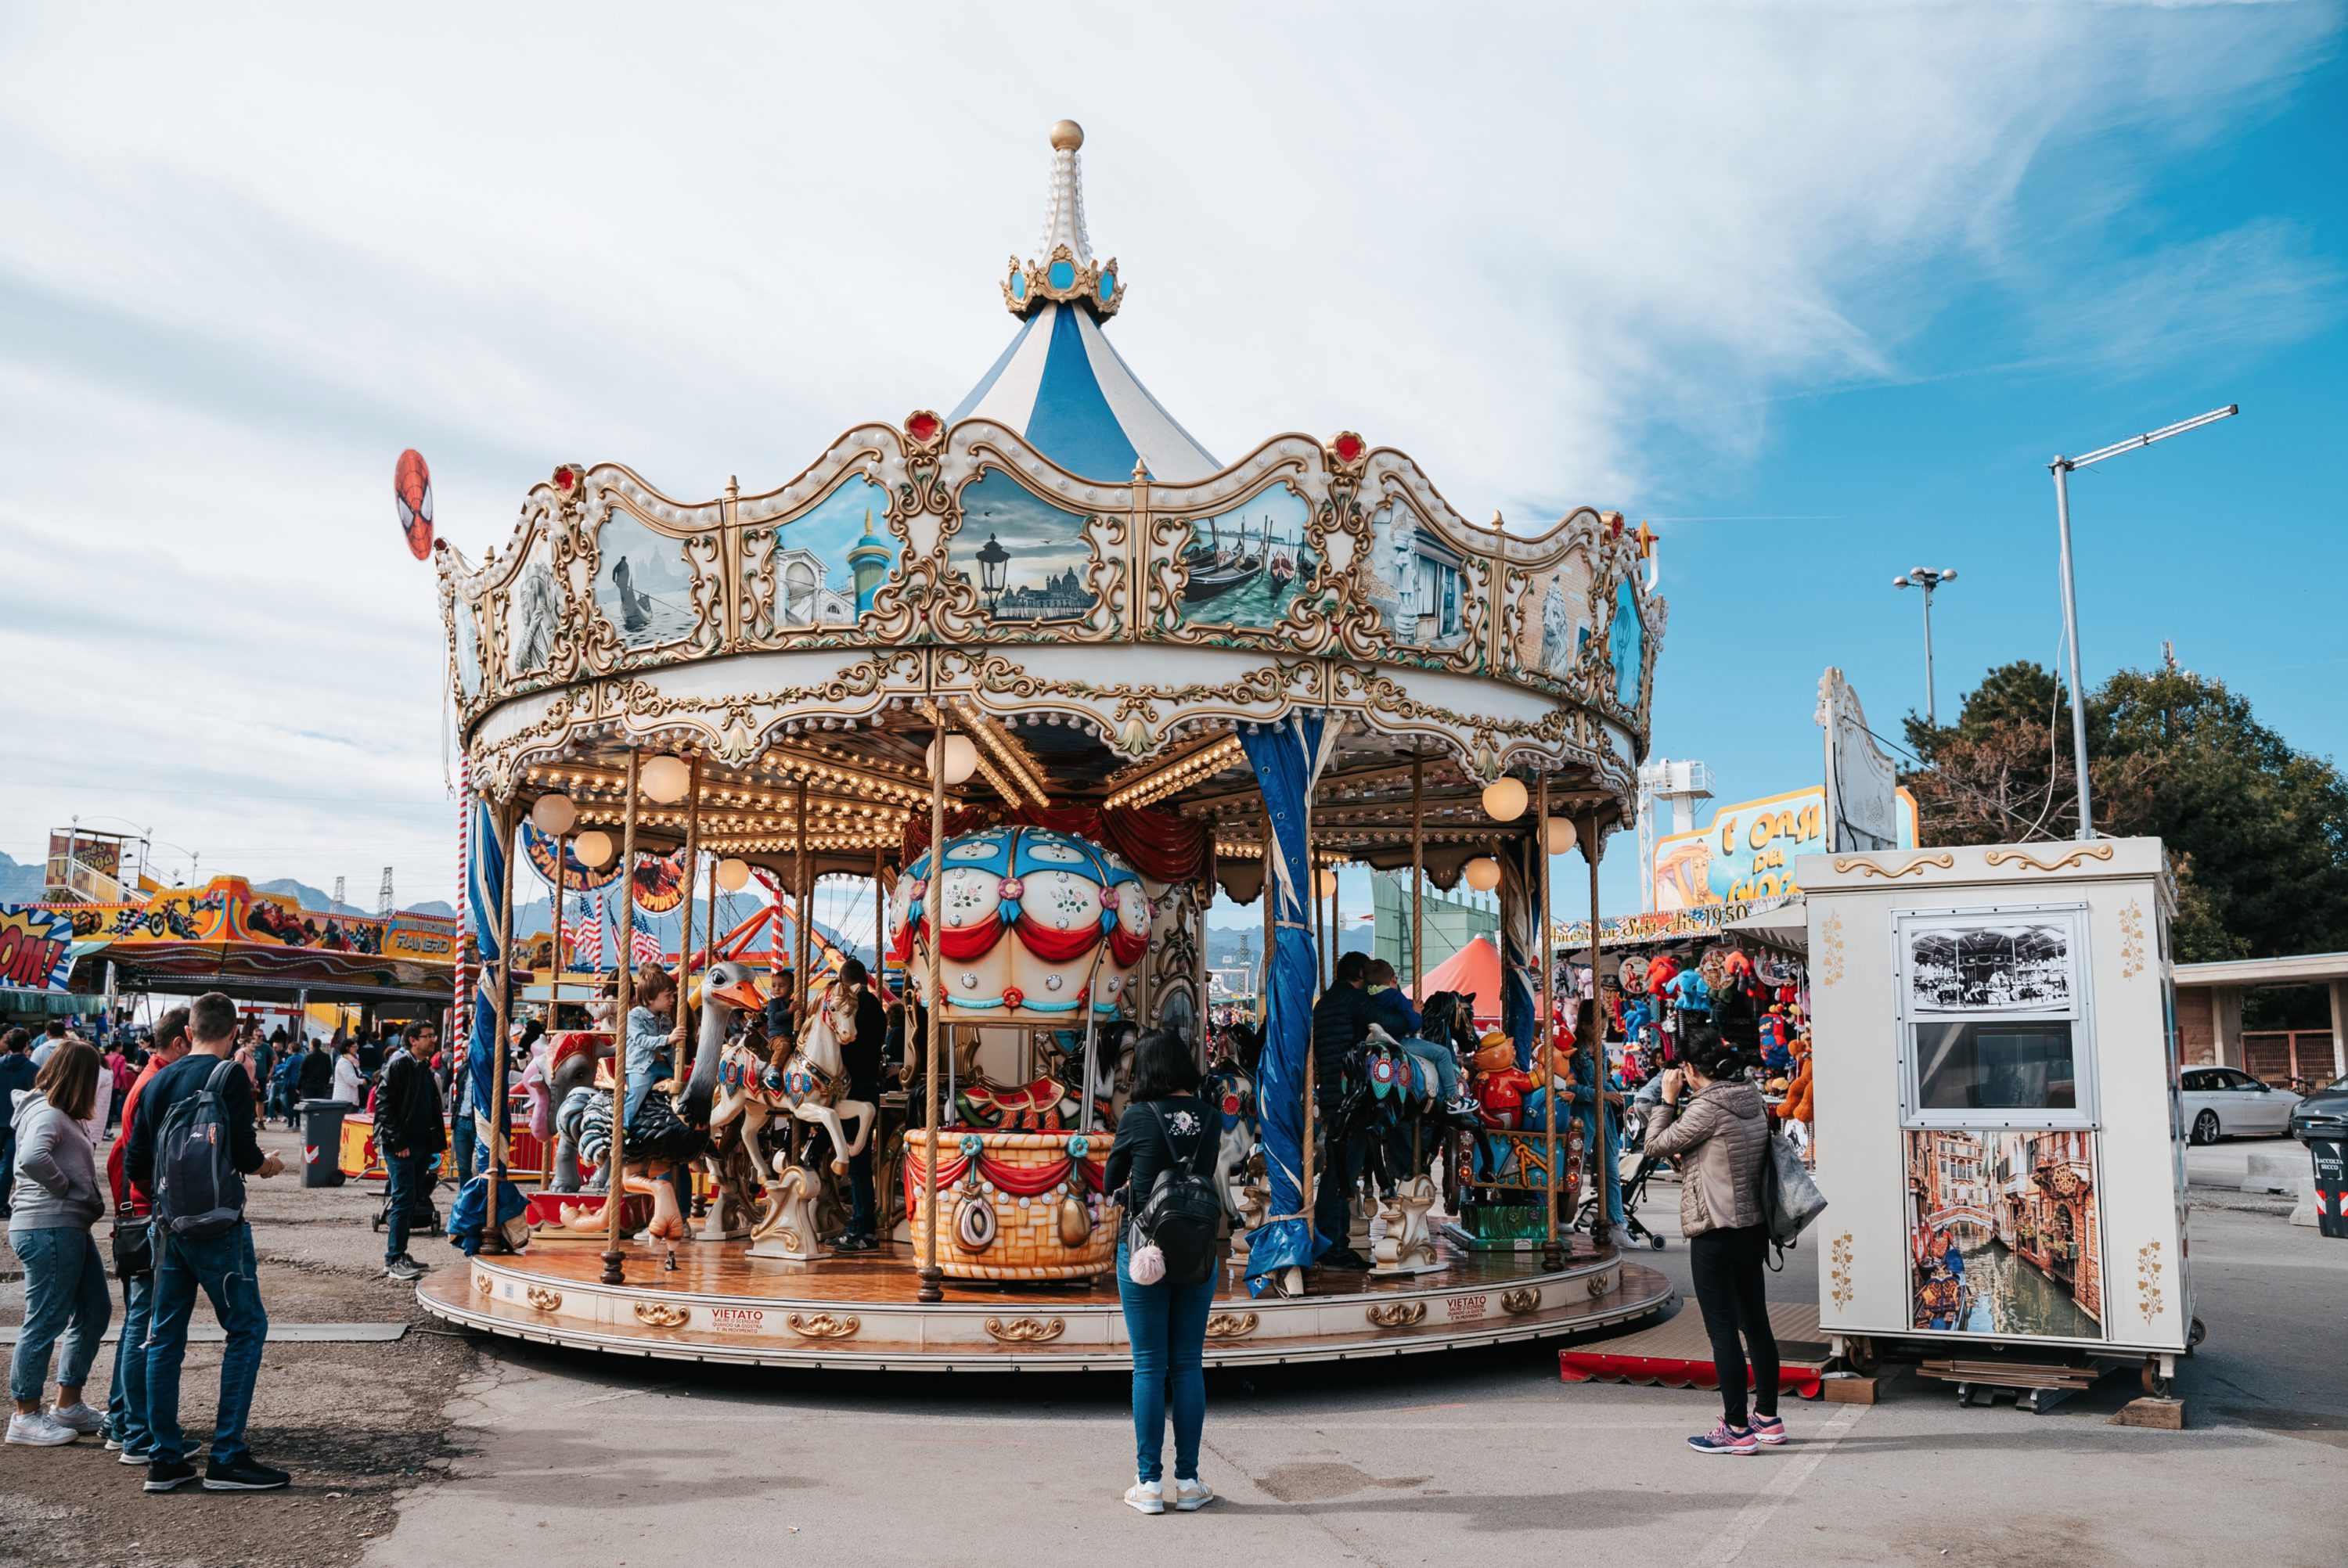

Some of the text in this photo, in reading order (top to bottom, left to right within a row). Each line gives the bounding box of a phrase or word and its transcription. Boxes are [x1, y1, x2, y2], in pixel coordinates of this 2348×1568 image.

[1749, 804, 1820, 851] OASI
[1752, 847, 1785, 875] DEL
[641, 890, 681, 912] SPIDER
[1623, 918, 1658, 937] Soft
[1666, 912, 1699, 933] Air
[1704, 904, 1748, 928] 1950
[711, 1308, 763, 1320] VIETATO
[1446, 1296, 1486, 1307] VIETATO
